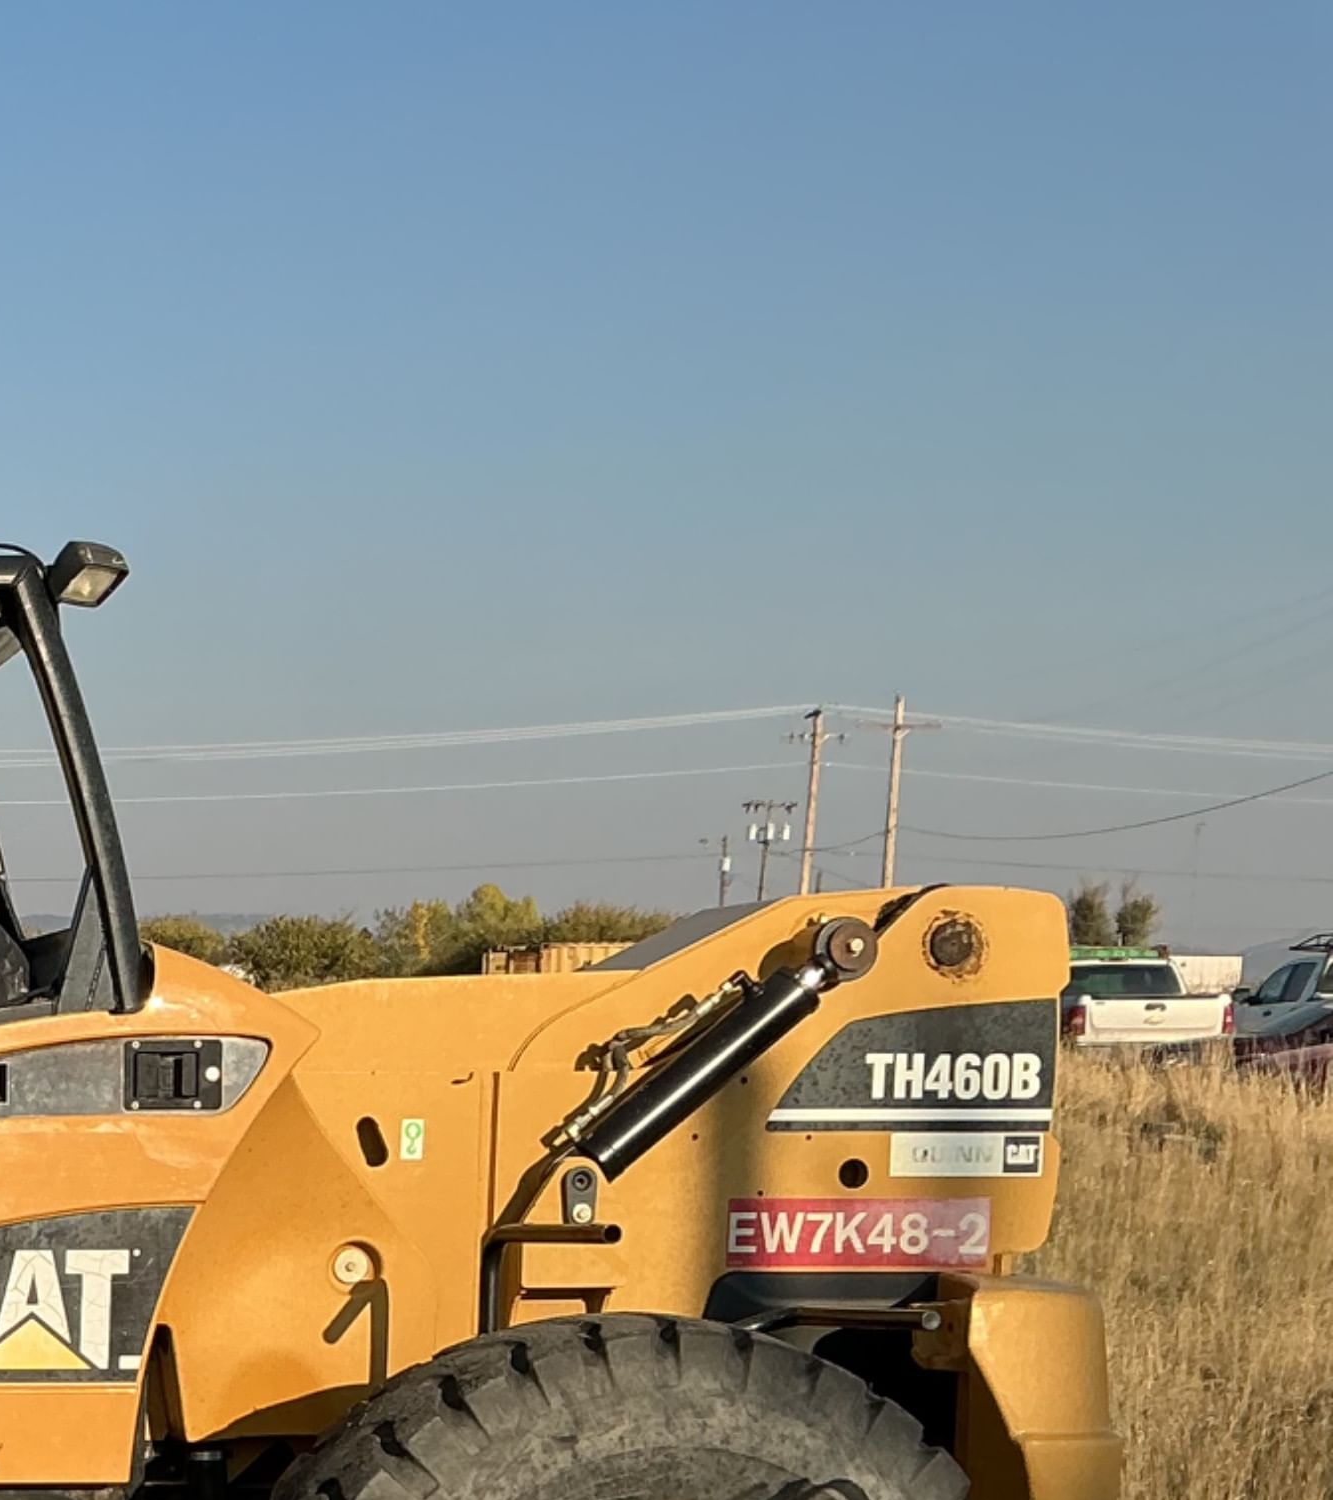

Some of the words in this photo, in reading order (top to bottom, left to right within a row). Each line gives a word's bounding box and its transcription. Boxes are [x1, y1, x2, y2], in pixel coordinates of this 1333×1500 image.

[865, 1052, 1042, 1100] TH460B
[911, 1145, 994, 1163] QUNN
[728, 1211, 987, 1255] EW7K48-2
